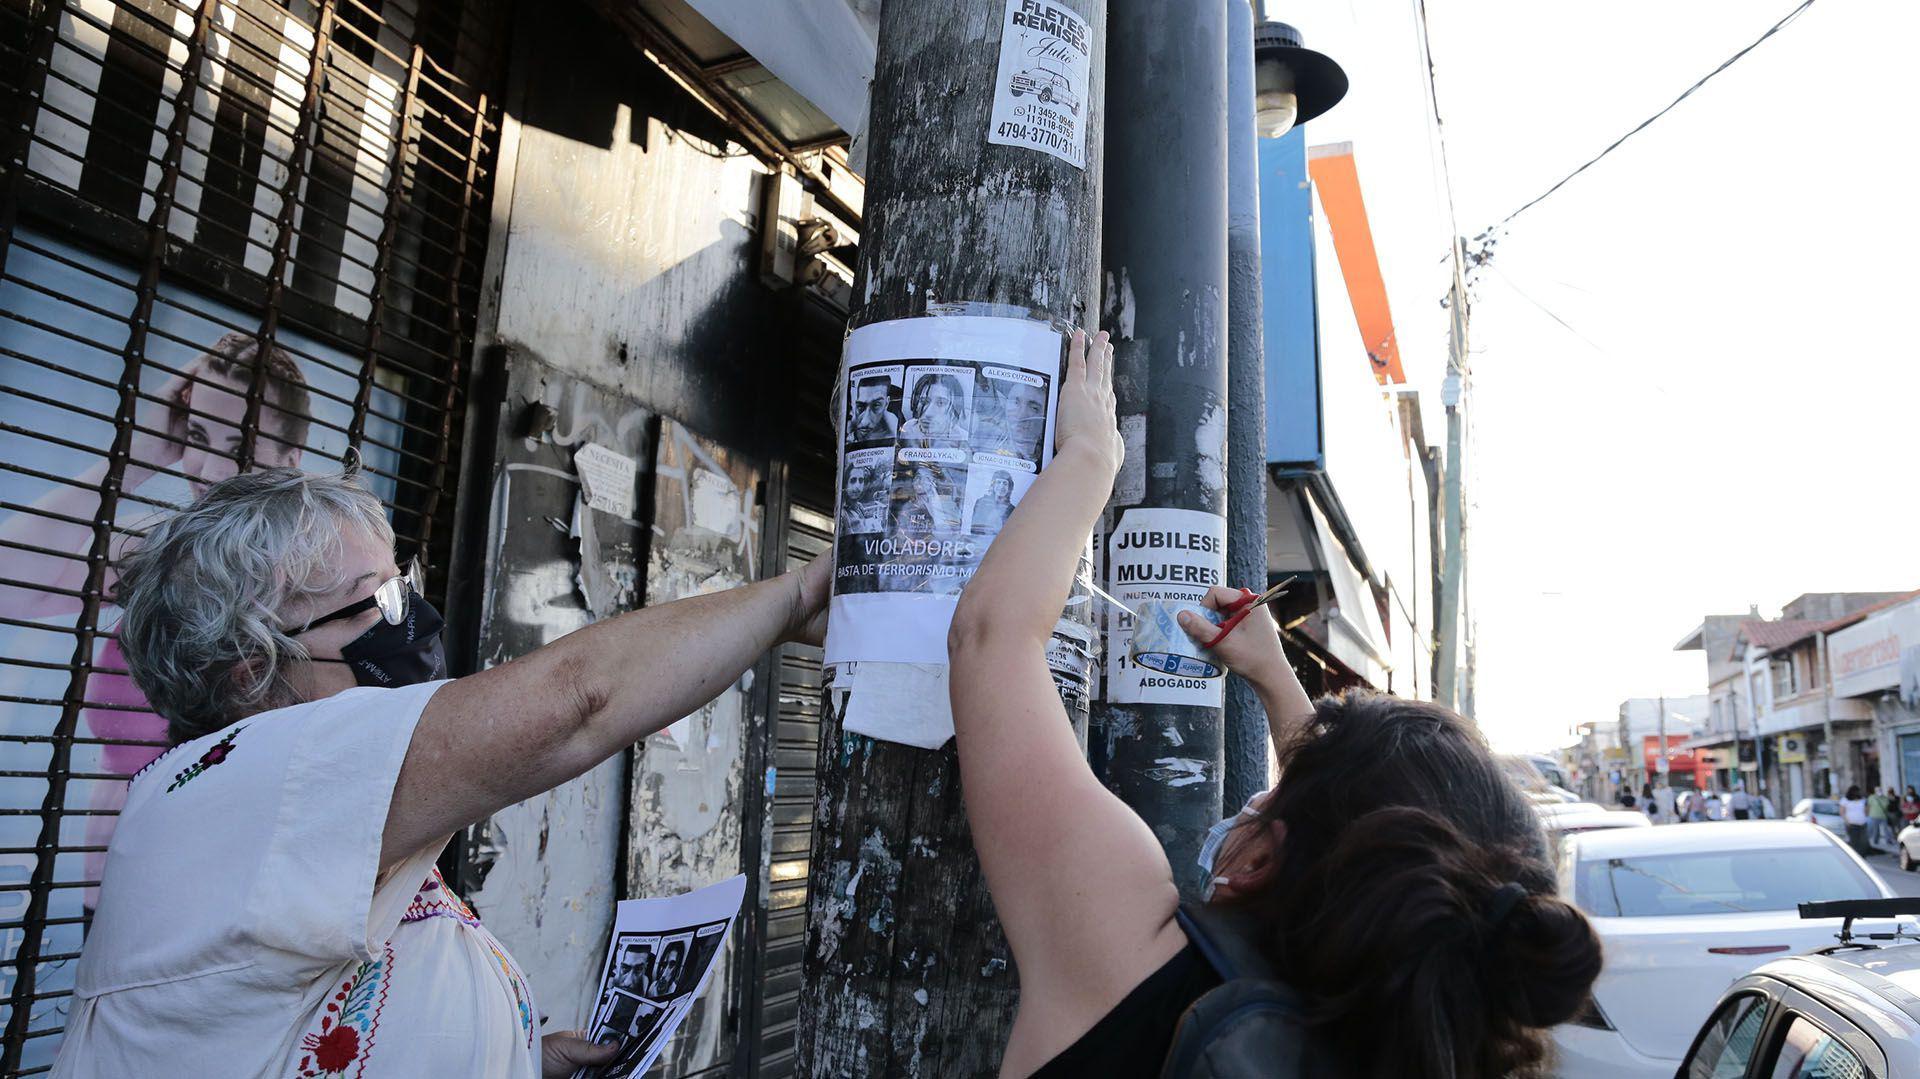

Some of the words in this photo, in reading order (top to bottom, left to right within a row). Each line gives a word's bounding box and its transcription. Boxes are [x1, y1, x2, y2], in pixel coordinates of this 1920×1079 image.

[1021, 0, 1085, 39] FLETES
[1012, 11, 1088, 56] REMISES
[987, 369, 1011, 378] ALEXIS
[904, 451, 932, 459] FRANCO
[864, 538, 976, 559] VIOLADORES
[1117, 531, 1221, 553] JUBILESE
[837, 564, 860, 578] BASTA
[861, 563, 875, 575] DE
[877, 563, 956, 577] TERRORISMO
[1117, 564, 1219, 585] MUJERES
[1163, 592, 1203, 602] MORATO
[1139, 677, 1208, 690] ABOGADOS
